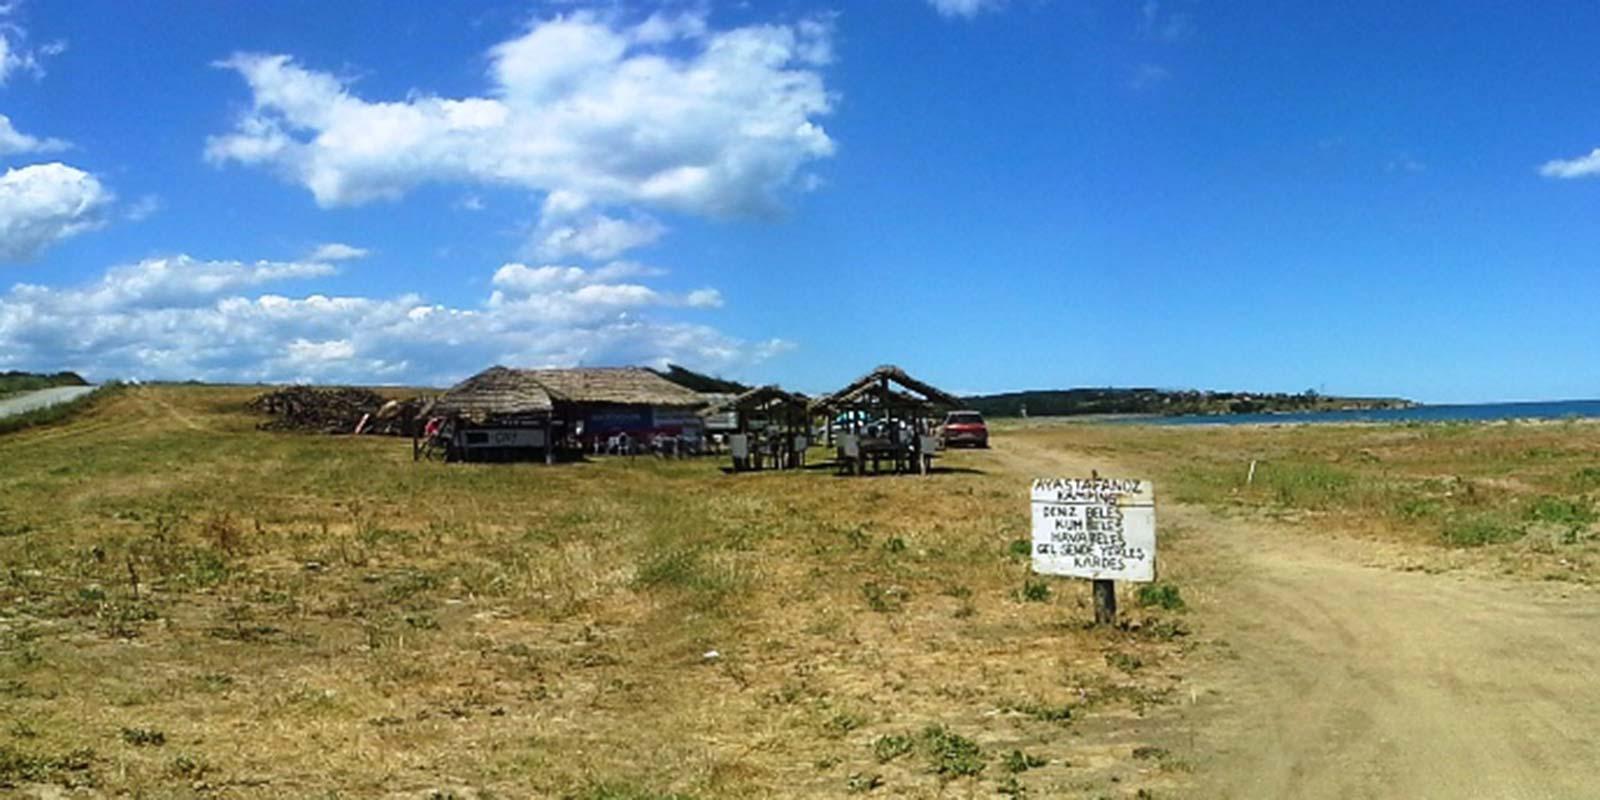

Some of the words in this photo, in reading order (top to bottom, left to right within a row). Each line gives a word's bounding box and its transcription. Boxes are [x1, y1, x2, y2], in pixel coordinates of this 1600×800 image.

[1055, 519, 1083, 531] KUM
[1051, 531, 1087, 543] HAVA
[1036, 544, 1057, 555] GEL
